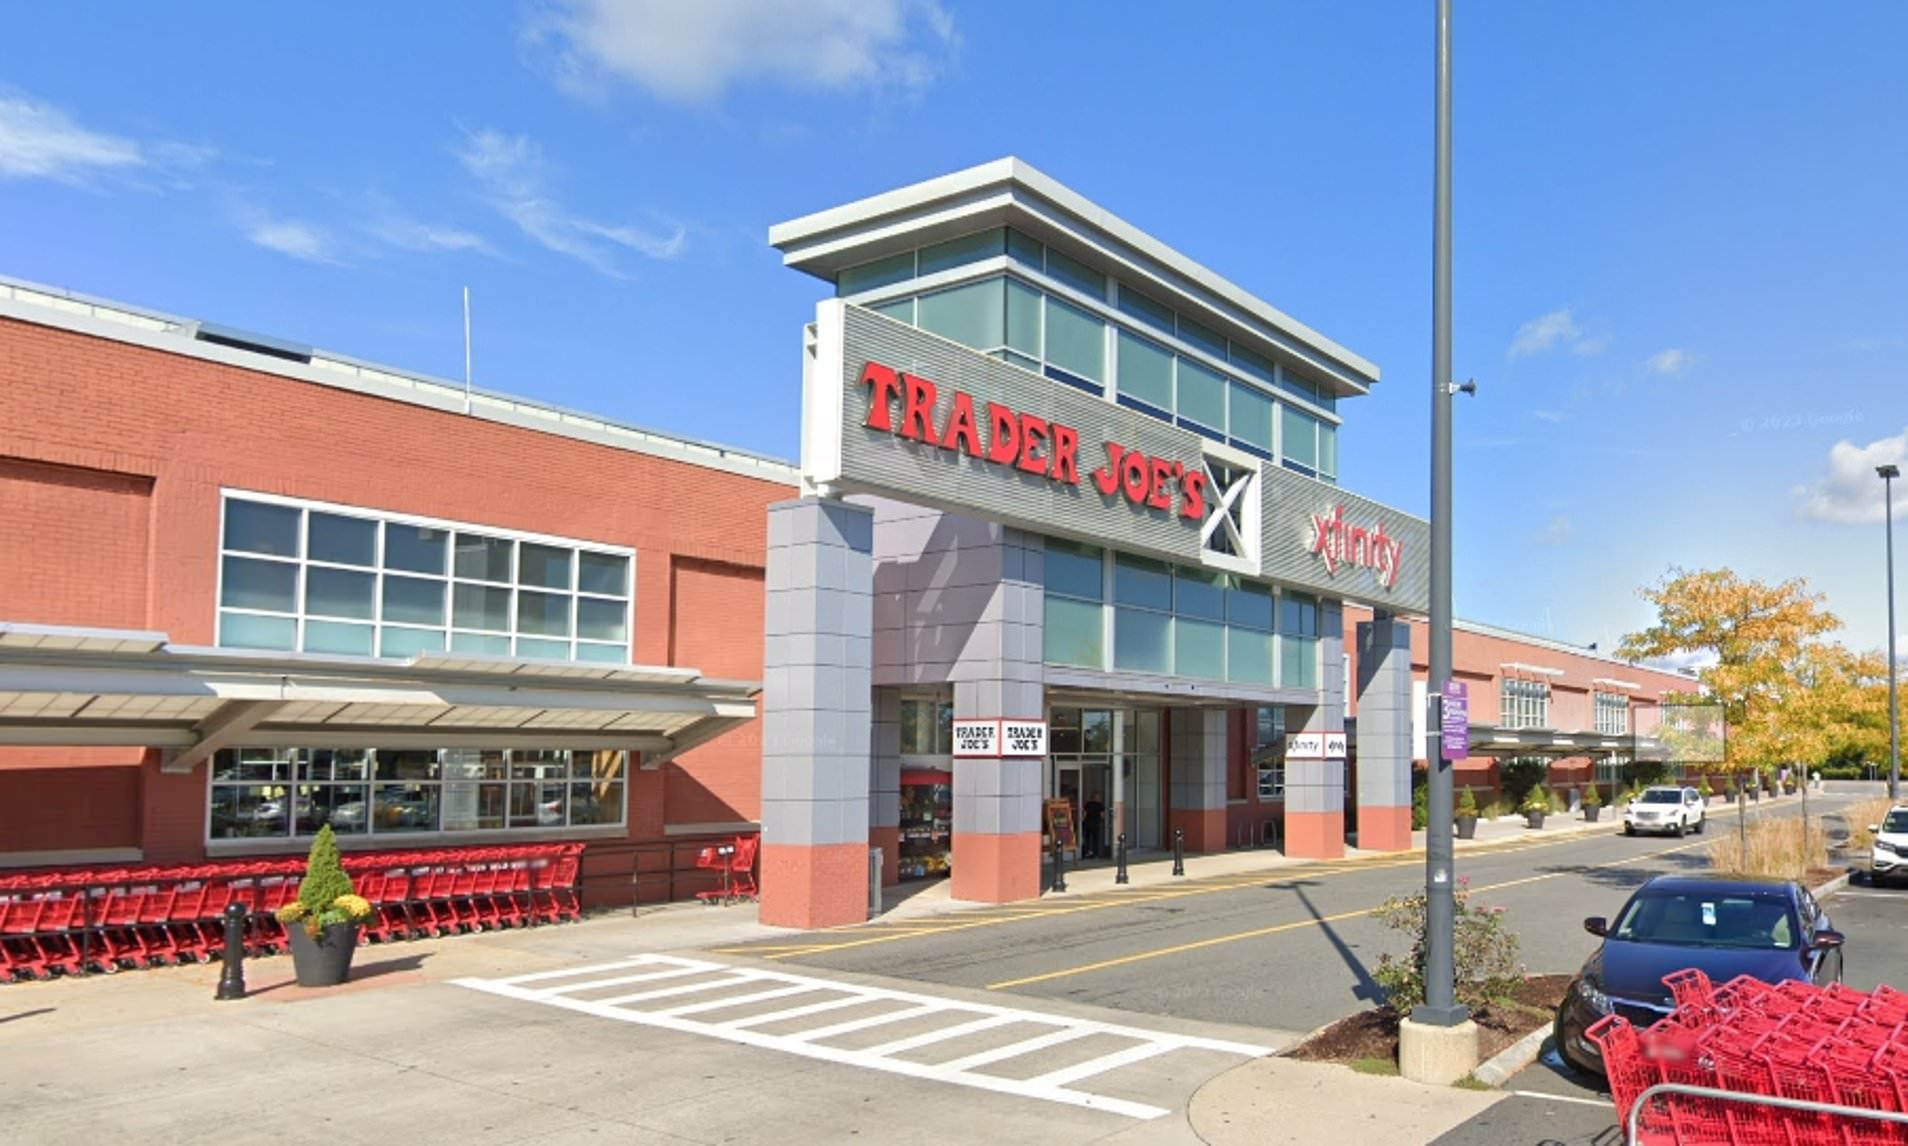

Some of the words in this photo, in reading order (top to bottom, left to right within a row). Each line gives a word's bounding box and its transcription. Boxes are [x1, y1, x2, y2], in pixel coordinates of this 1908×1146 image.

[860, 360, 1081, 486] TRADER
[1093, 441, 1207, 520] JOE'S
[1310, 503, 1404, 588] xfinity
[956, 727, 995, 738] TRADER
[1007, 727, 1042, 739] TRADER
